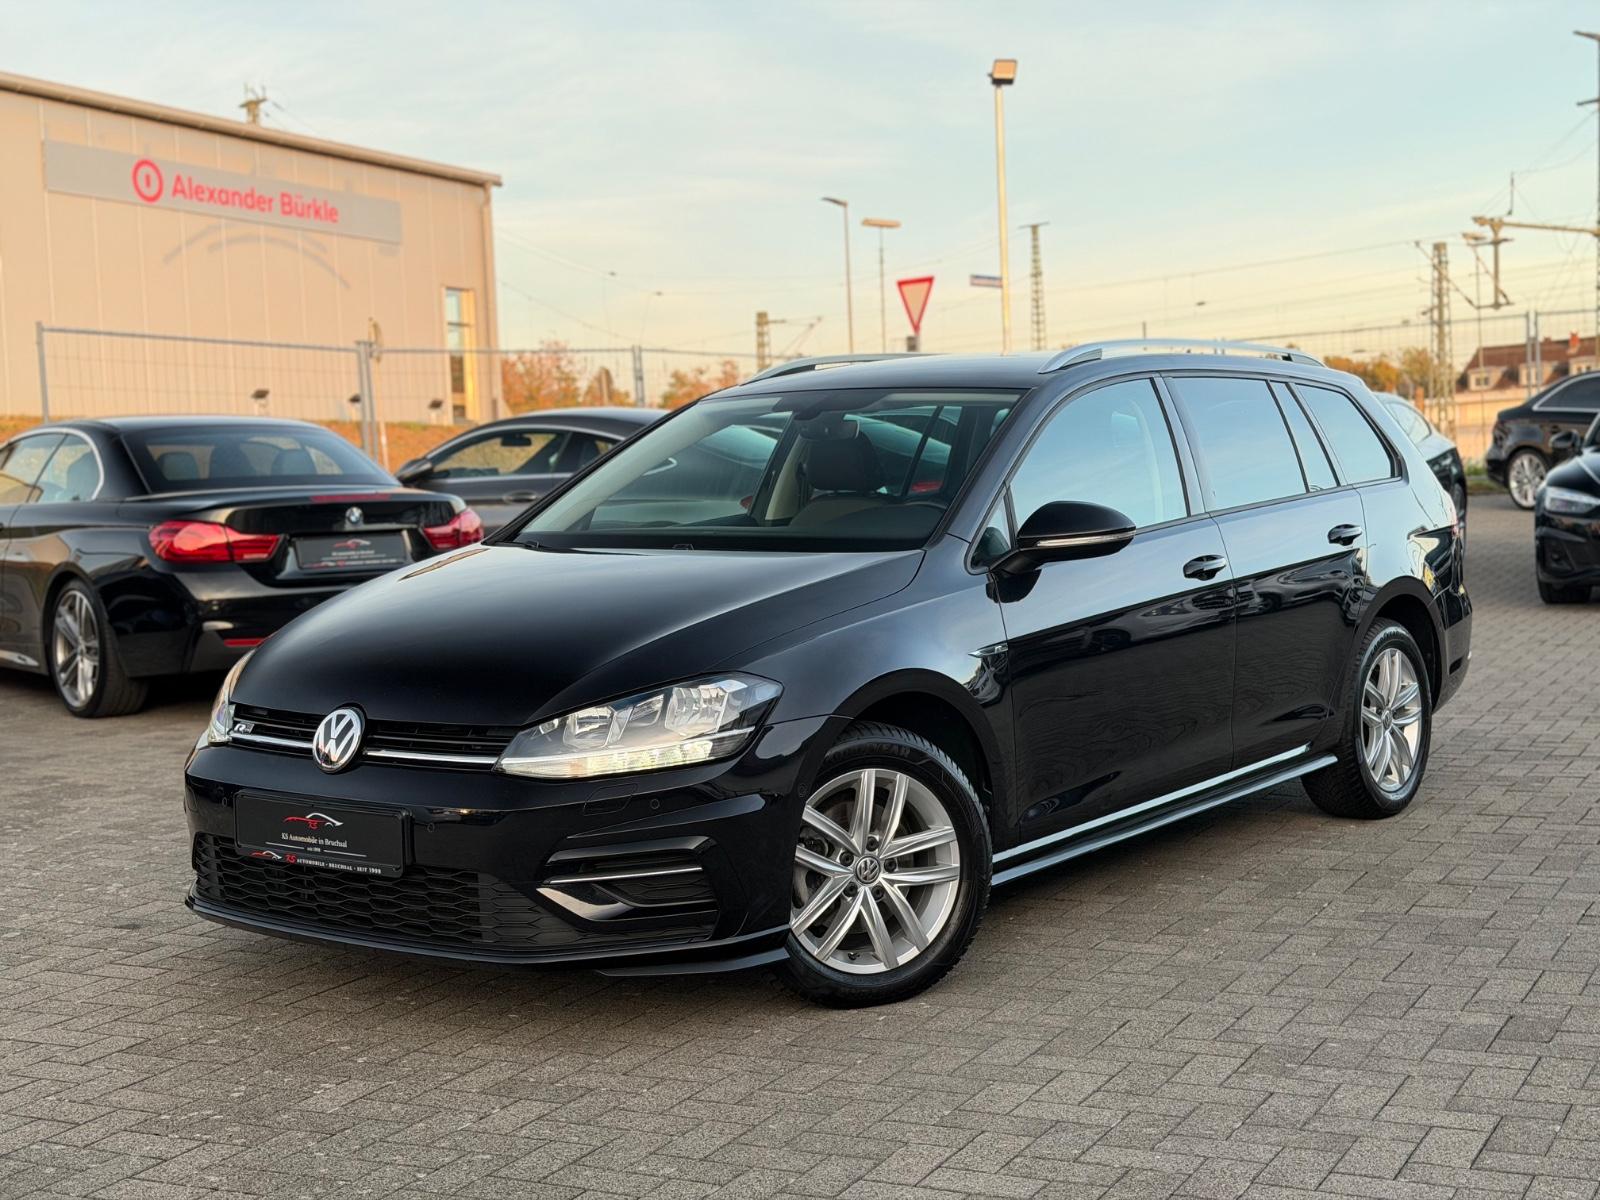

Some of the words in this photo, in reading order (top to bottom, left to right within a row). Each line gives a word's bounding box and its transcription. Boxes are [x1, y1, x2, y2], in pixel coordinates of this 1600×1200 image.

[172, 174, 275, 213] Alexander
[279, 192, 339, 224] Bürkle
[315, 708, 361, 769] VW
[281, 832, 288, 840] KS
[289, 833, 318, 844] Automobile
[318, 837, 324, 845] in
[324, 838, 348, 848] Bruchsal
